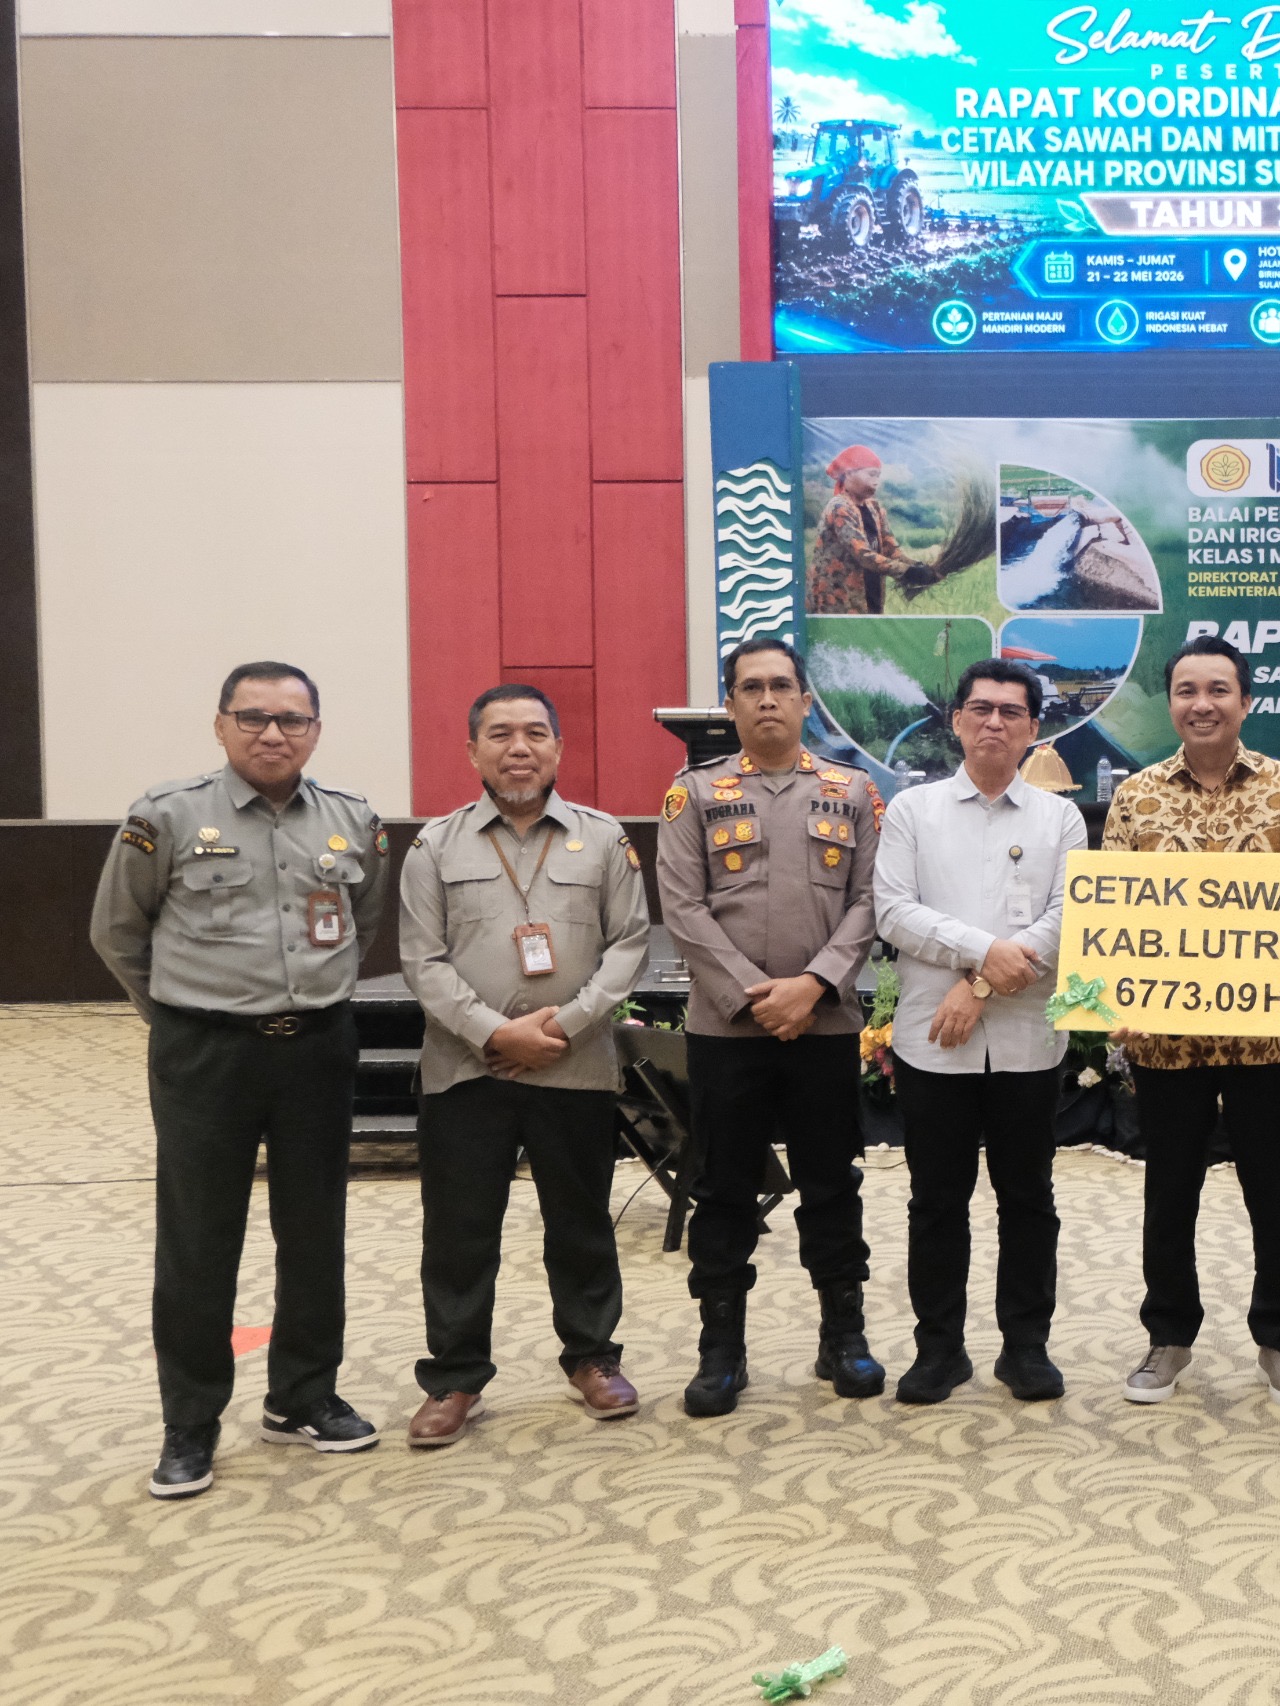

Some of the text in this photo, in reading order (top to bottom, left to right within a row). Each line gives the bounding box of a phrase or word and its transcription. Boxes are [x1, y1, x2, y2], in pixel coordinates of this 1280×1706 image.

[1046, 5, 1231, 66] Selamat
[955, 88, 1080, 119] RAPAT
[941, 126, 1034, 154] CETAK
[1044, 126, 1151, 153] SAWAH
[1161, 126, 1222, 152] DAN
[961, 160, 1095, 187] WILAYAH
[1104, 159, 1246, 186] PROVINSI
[1131, 201, 1262, 228] TAHUN
[1086, 254, 1125, 266] KAMIS
[1136, 254, 1176, 266] JUMAT
[1086, 271, 1100, 282] 21
[1113, 271, 1128, 282] 22
[1131, 271, 1153, 282] MEI
[1155, 271, 1185, 282] 2026
[982, 311, 1063, 321] PERTANIAN MAJU
[1145, 311, 1206, 321] IRIGASI KUAT
[982, 323, 1066, 334] MANDIRI MODERN
[1145, 323, 1228, 334] INDONESIA HEBAT
[1188, 507, 1249, 523] BALAI
[1188, 528, 1236, 544] DAN
[1188, 549, 1253, 565] KELAS
[1256, 549, 1265, 564] 1
[1188, 572, 1278, 583] DIREKTORAT
[704, 803, 756, 822] NUGRAHA
[811, 800, 858, 819] POLRI
[1069, 875, 1189, 906] CETAK
[1082, 927, 1170, 958] KAB.
[1115, 977, 1257, 1013] 6773,09
